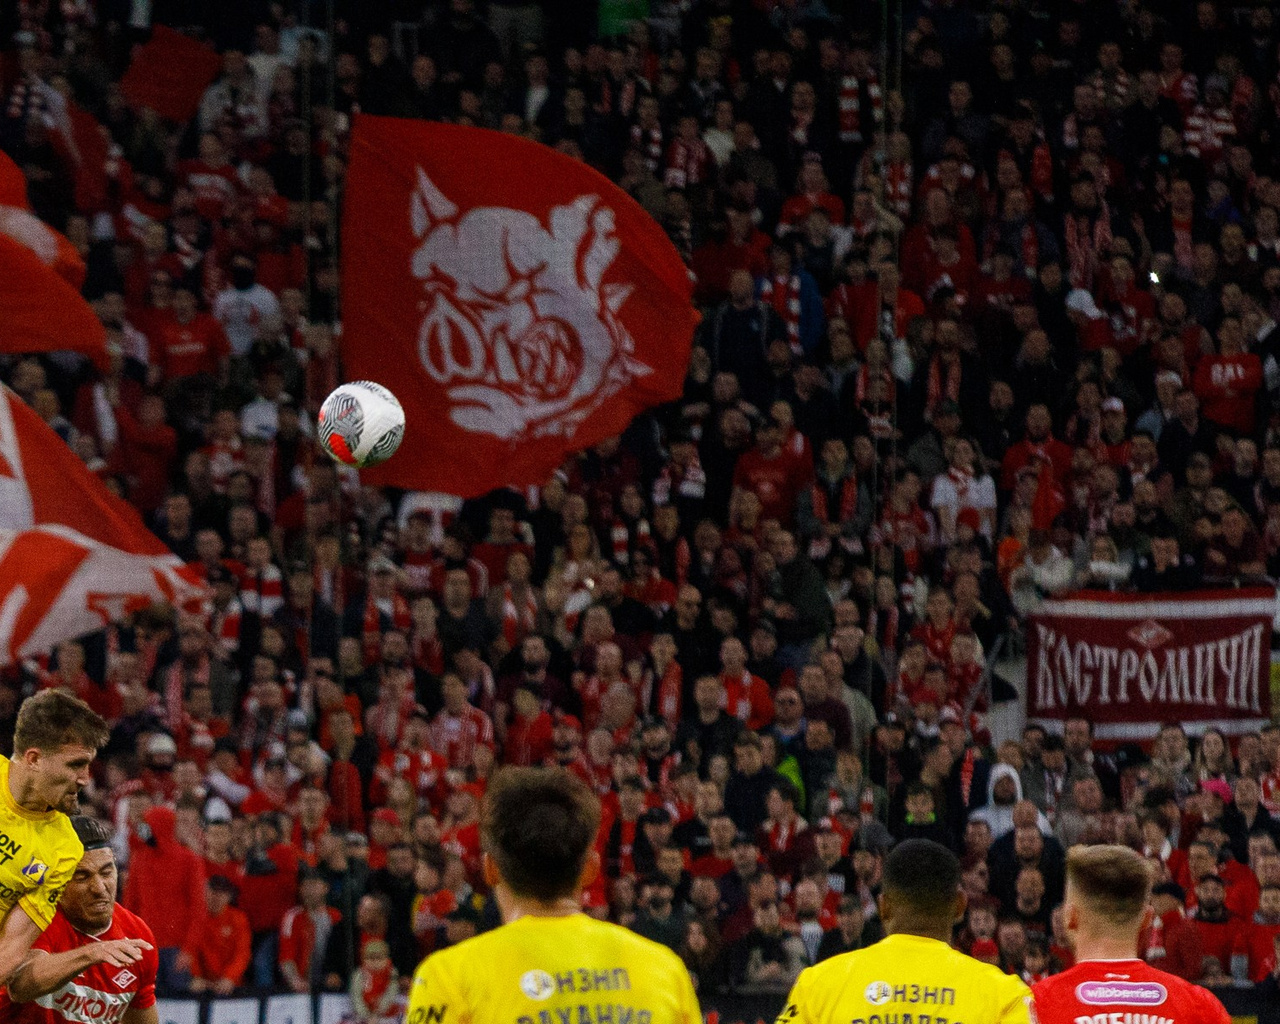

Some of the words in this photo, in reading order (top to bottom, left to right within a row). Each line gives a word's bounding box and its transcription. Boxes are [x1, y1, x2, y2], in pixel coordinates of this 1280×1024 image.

[1036, 621, 1263, 712] КОСТРОМИЧИ
[894, 984, 955, 1006] НЗНП
[1086, 986, 1160, 999] wildberries
